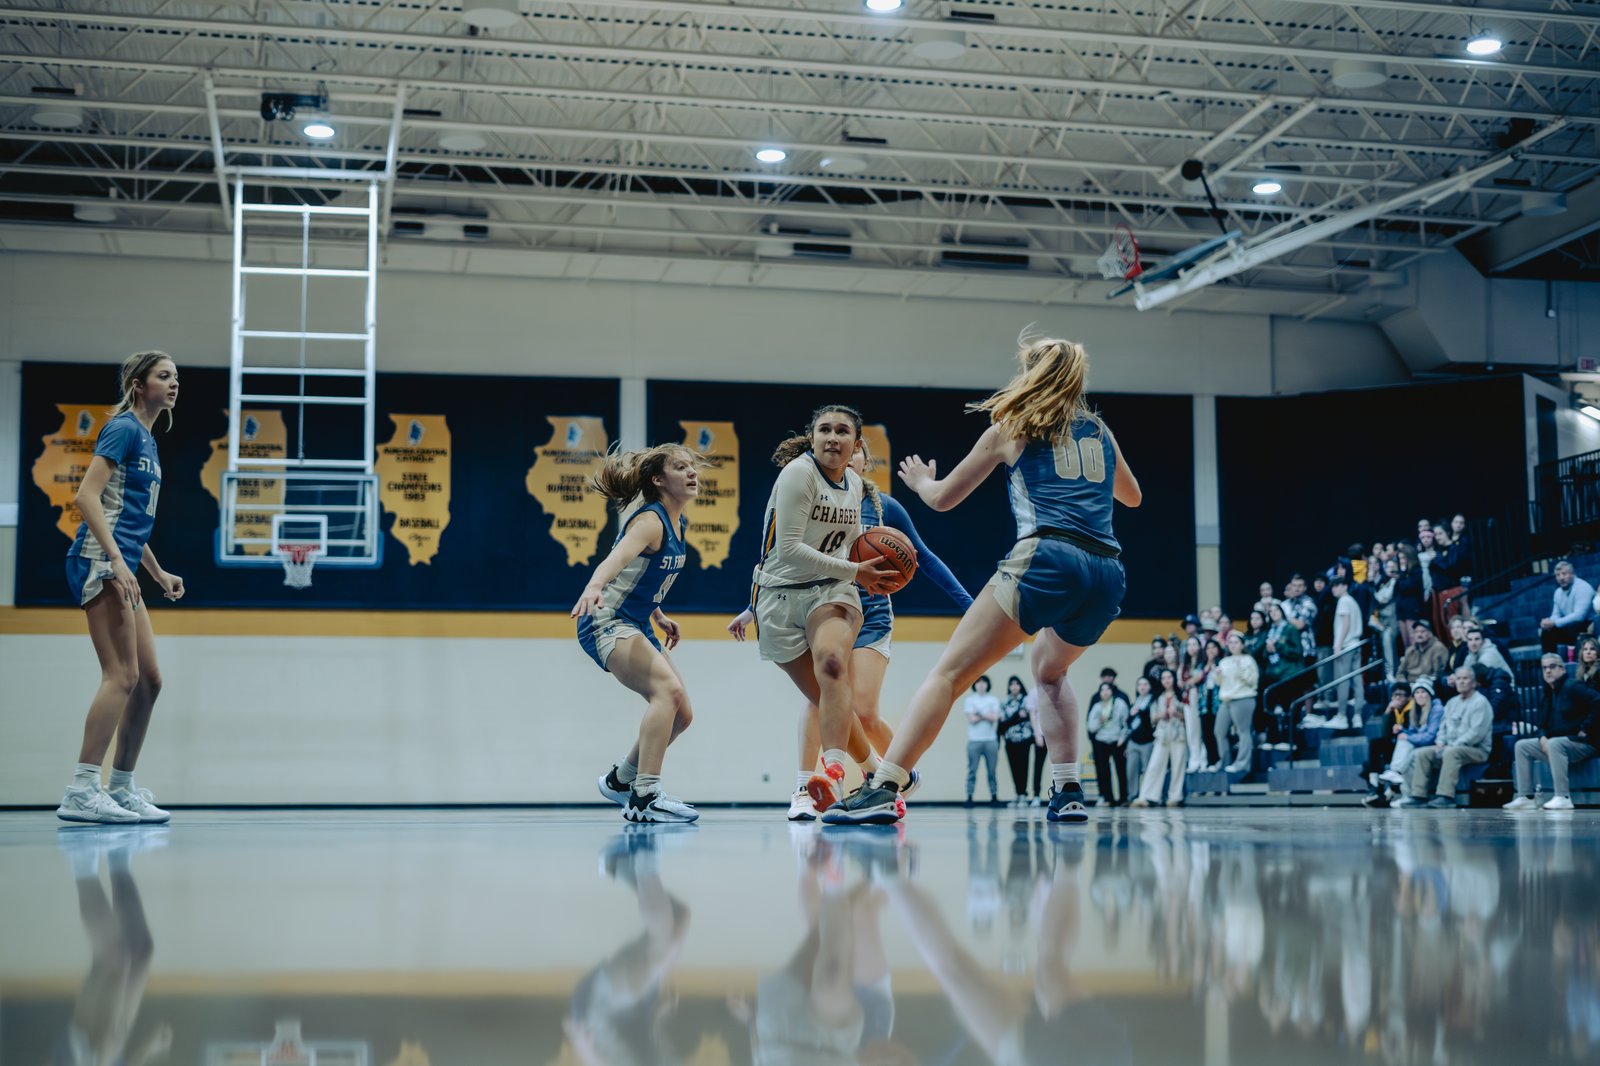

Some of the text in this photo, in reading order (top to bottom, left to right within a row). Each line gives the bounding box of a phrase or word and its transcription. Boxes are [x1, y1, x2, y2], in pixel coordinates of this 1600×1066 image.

[1053, 436, 1105, 483] 00
[402, 472, 428, 482] STATE
[387, 482, 442, 492] CHAMPIONS
[400, 517, 440, 529] BASEBALL
[556, 517, 597, 529] BASEBALL
